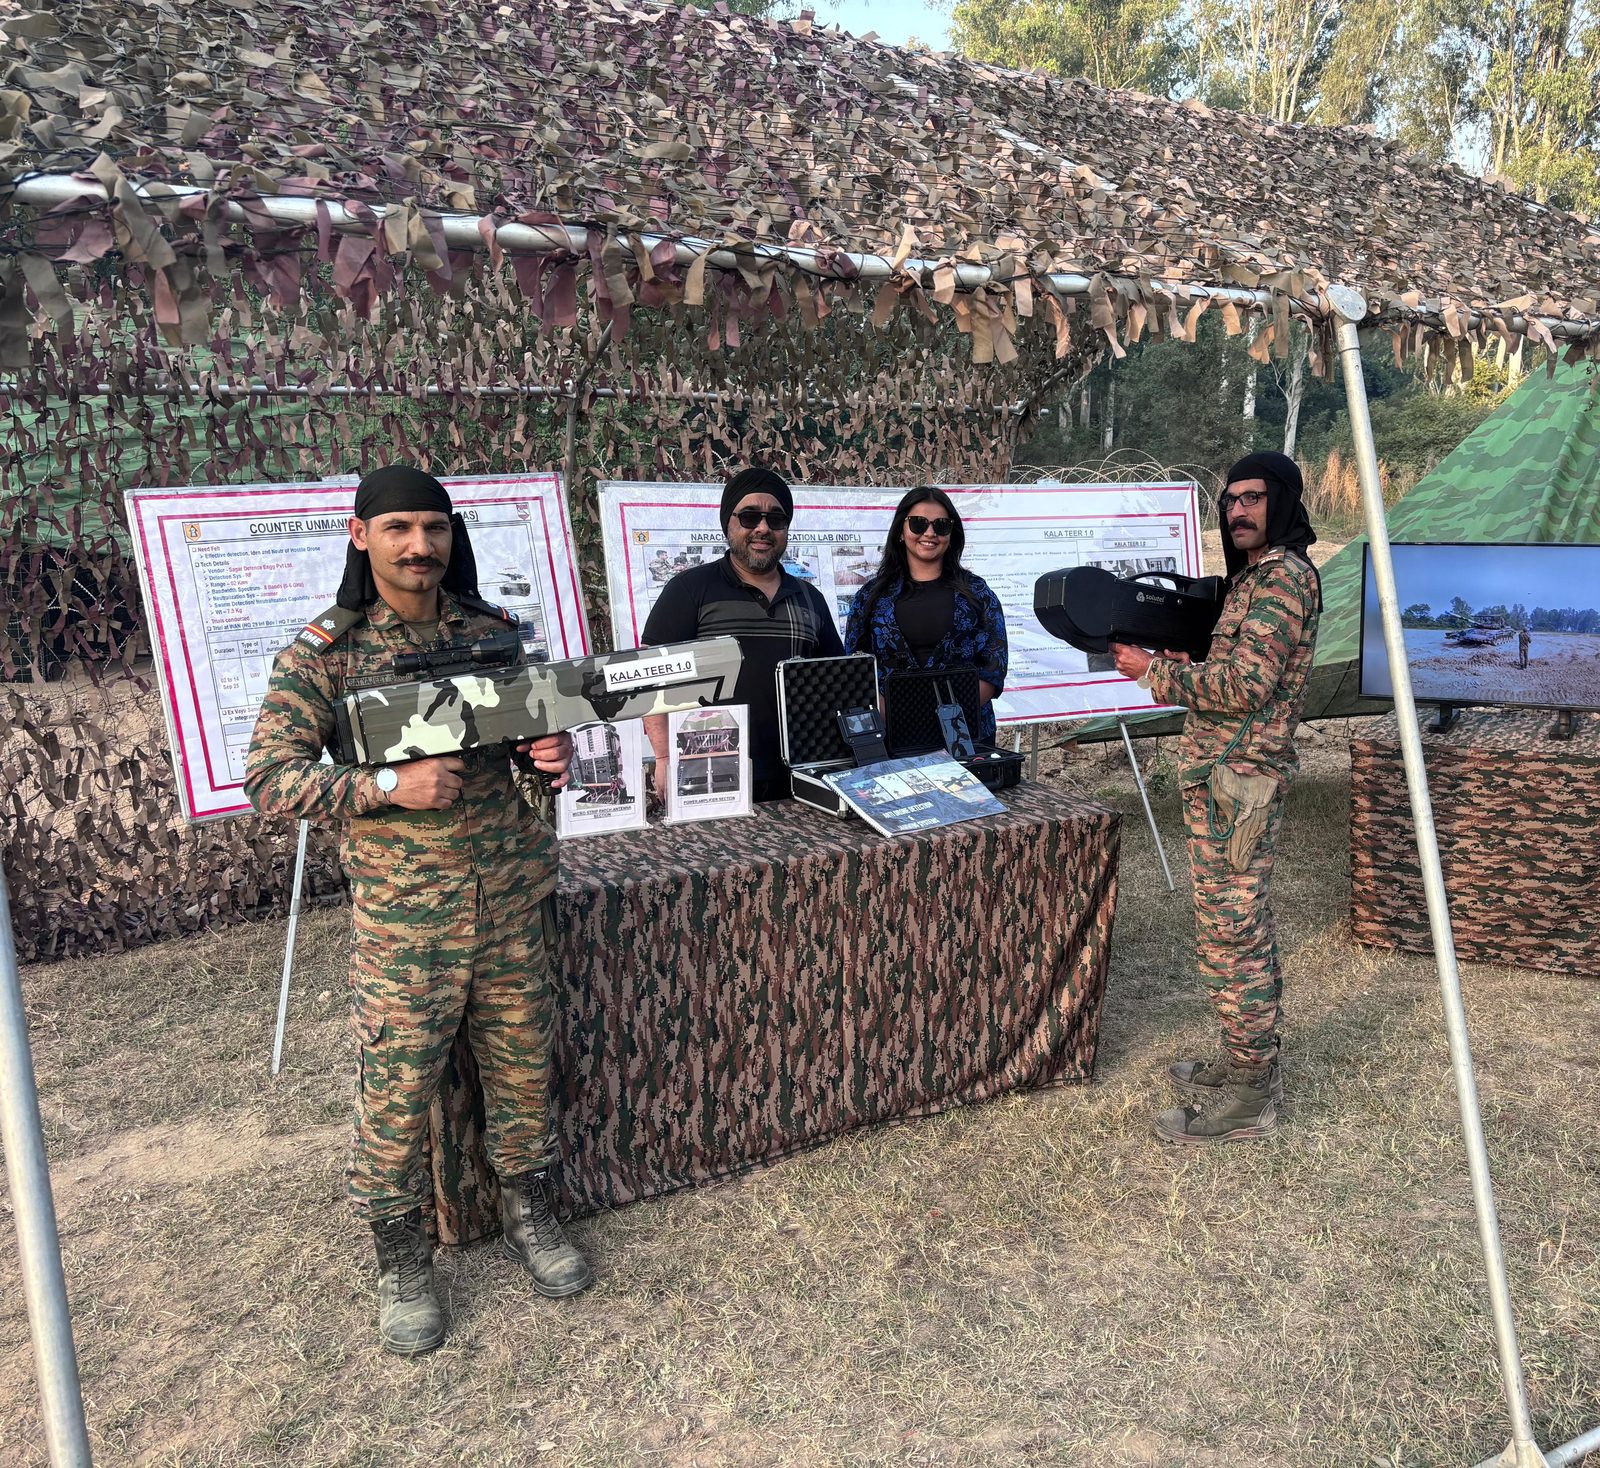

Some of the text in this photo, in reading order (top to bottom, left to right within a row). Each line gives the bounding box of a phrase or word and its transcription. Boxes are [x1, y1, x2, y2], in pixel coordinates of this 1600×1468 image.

[250, 521, 303, 533] COUNTER
[460, 510, 478, 521] AS)
[818, 533, 833, 541] LAB
[836, 533, 861, 542] (NDFL)
[301, 630, 323, 646] EME
[610, 661, 692, 682] KALA TEER 1.0
